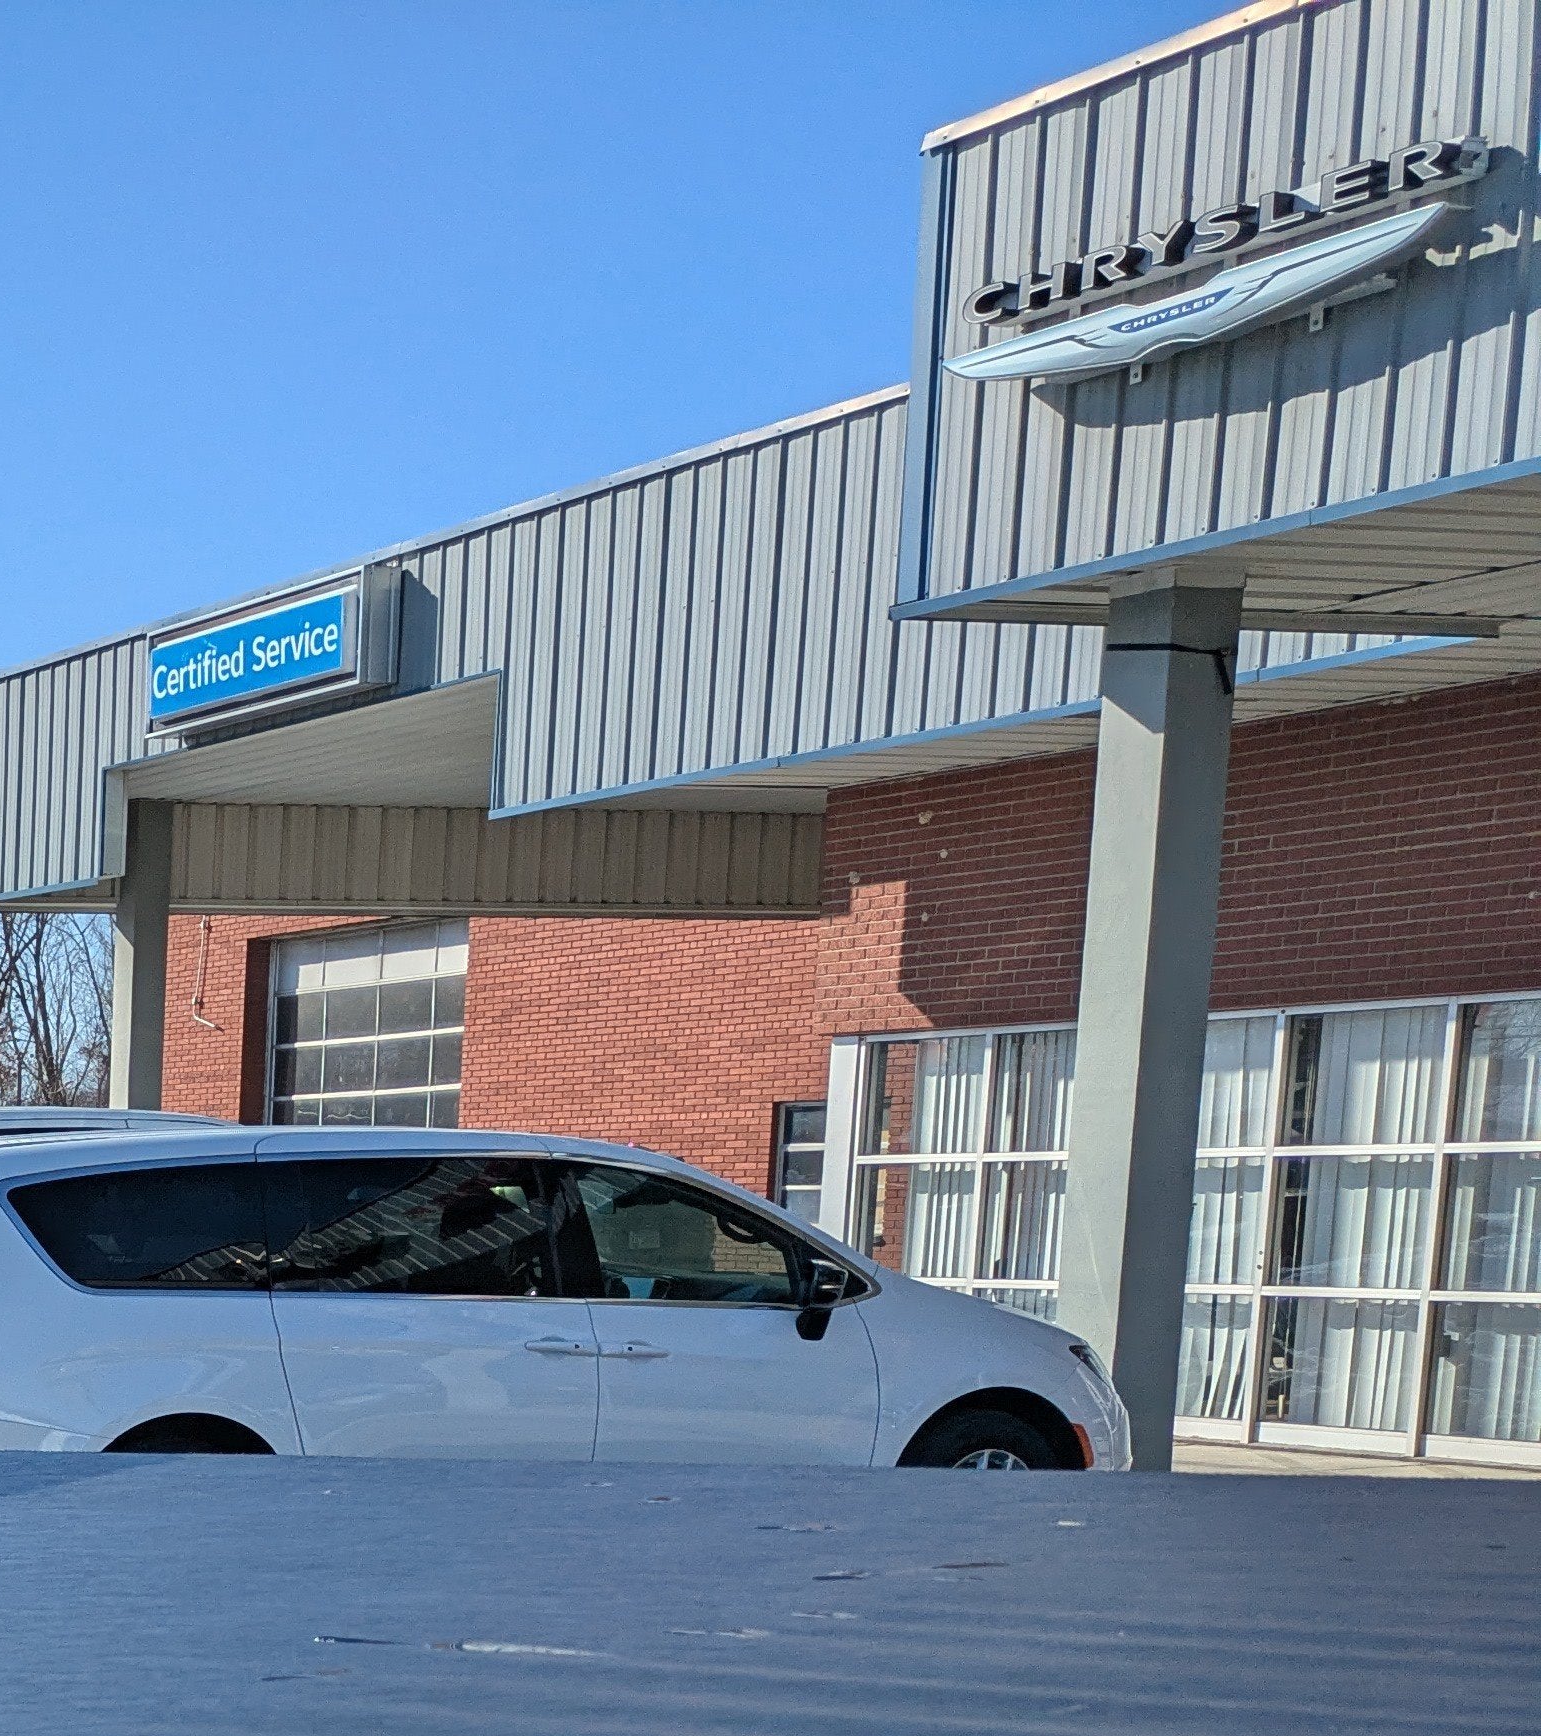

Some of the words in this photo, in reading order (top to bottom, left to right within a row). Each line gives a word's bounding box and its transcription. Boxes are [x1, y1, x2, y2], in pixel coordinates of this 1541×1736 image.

[963, 140, 1449, 325] CHRYSLER
[1120, 296, 1216, 331] CHRYSLER
[153, 640, 245, 699] Certified
[251, 621, 339, 672] Service
